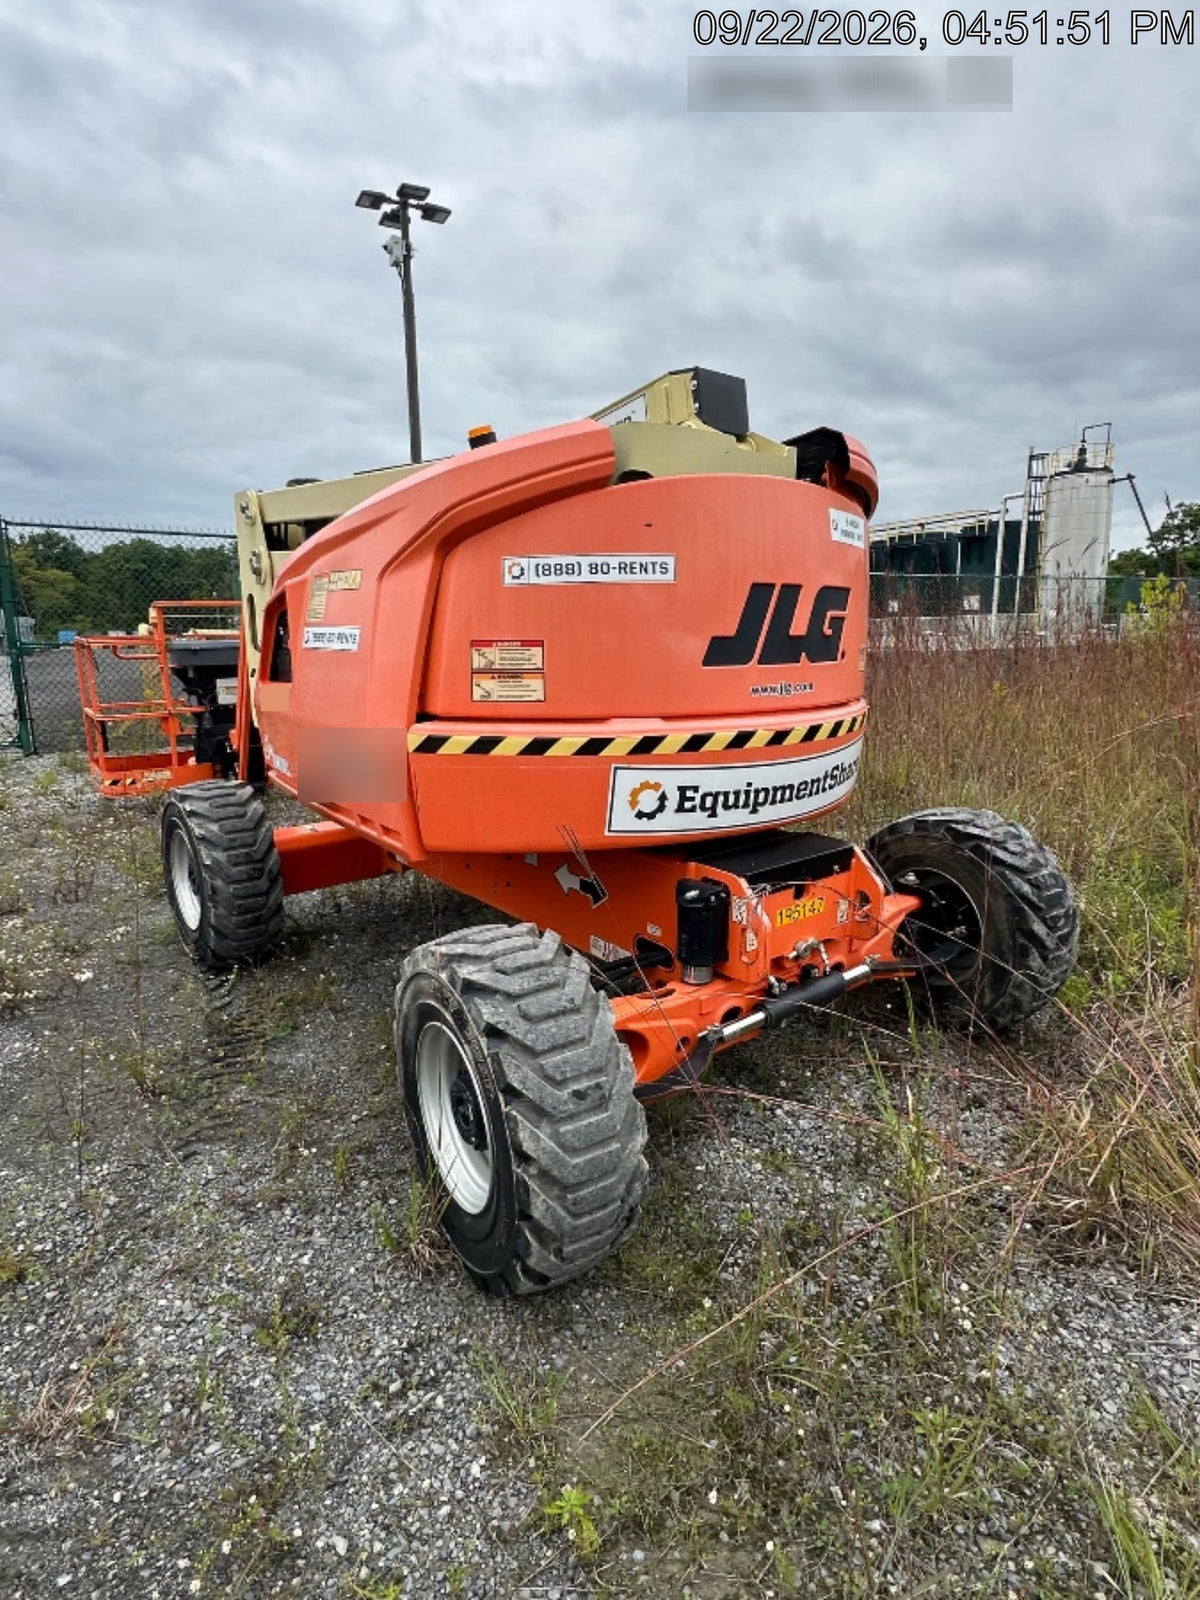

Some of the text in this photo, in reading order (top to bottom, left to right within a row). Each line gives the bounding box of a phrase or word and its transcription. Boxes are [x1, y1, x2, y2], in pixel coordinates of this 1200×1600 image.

[534, 561, 669, 578] (888) 80-RENTS
[702, 582, 851, 667] JLG
[751, 682, 814, 695] www.jlg.com
[675, 756, 860, 818] EquipmentShar
